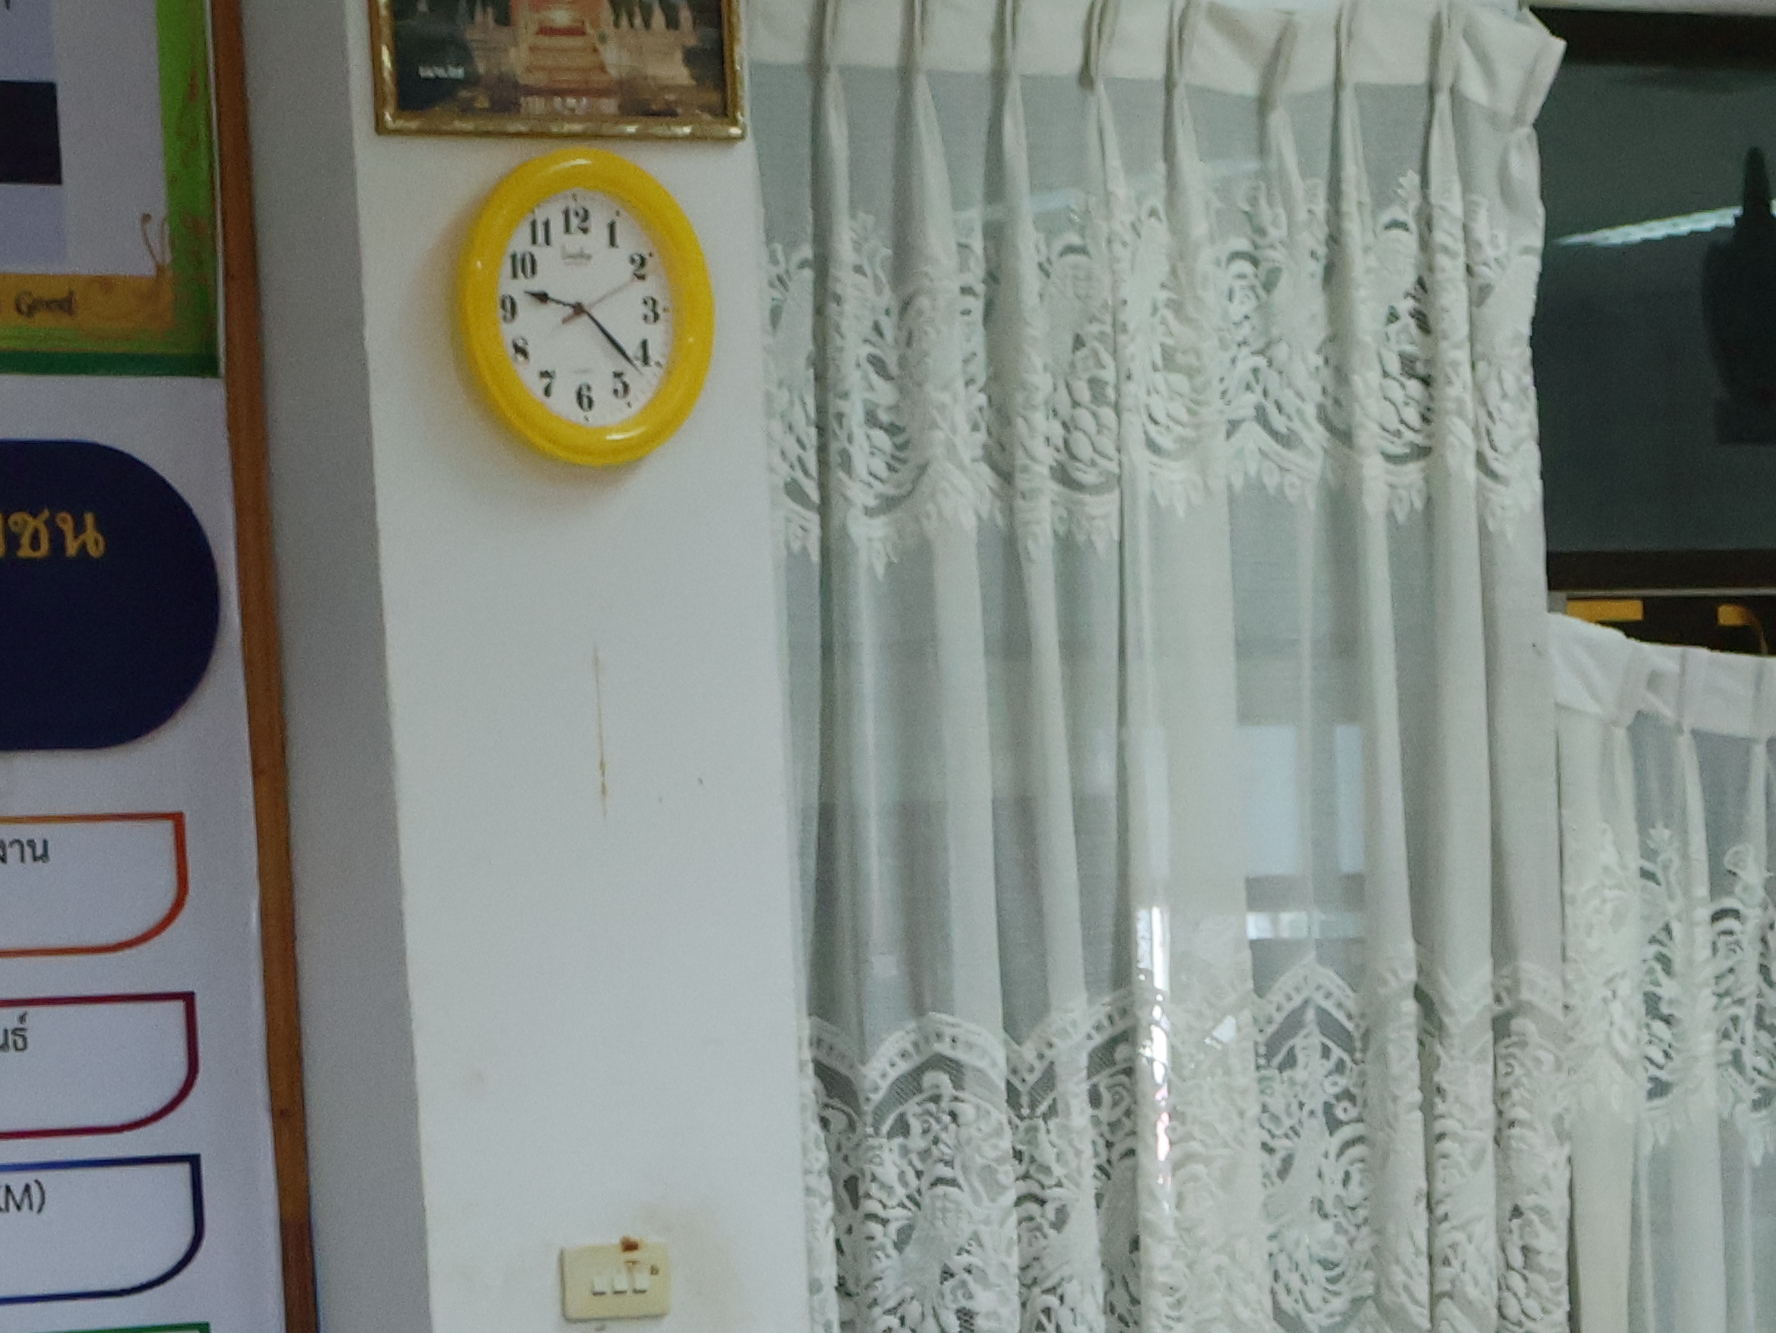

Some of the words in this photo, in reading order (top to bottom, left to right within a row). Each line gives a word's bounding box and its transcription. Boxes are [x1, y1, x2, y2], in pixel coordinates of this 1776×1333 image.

[530, 217, 552, 247] 11
[562, 206, 590, 236] 12
[606, 219, 620, 249] 1
[509, 251, 538, 280] 10
[629, 252, 648, 281] 2
[500, 294, 517, 324] 9
[642, 295, 660, 325] 3
[635, 338, 652, 368] 4
[539, 369, 556, 399] 7
[576, 383, 594, 412] 6
[612, 371, 630, 401] 5
